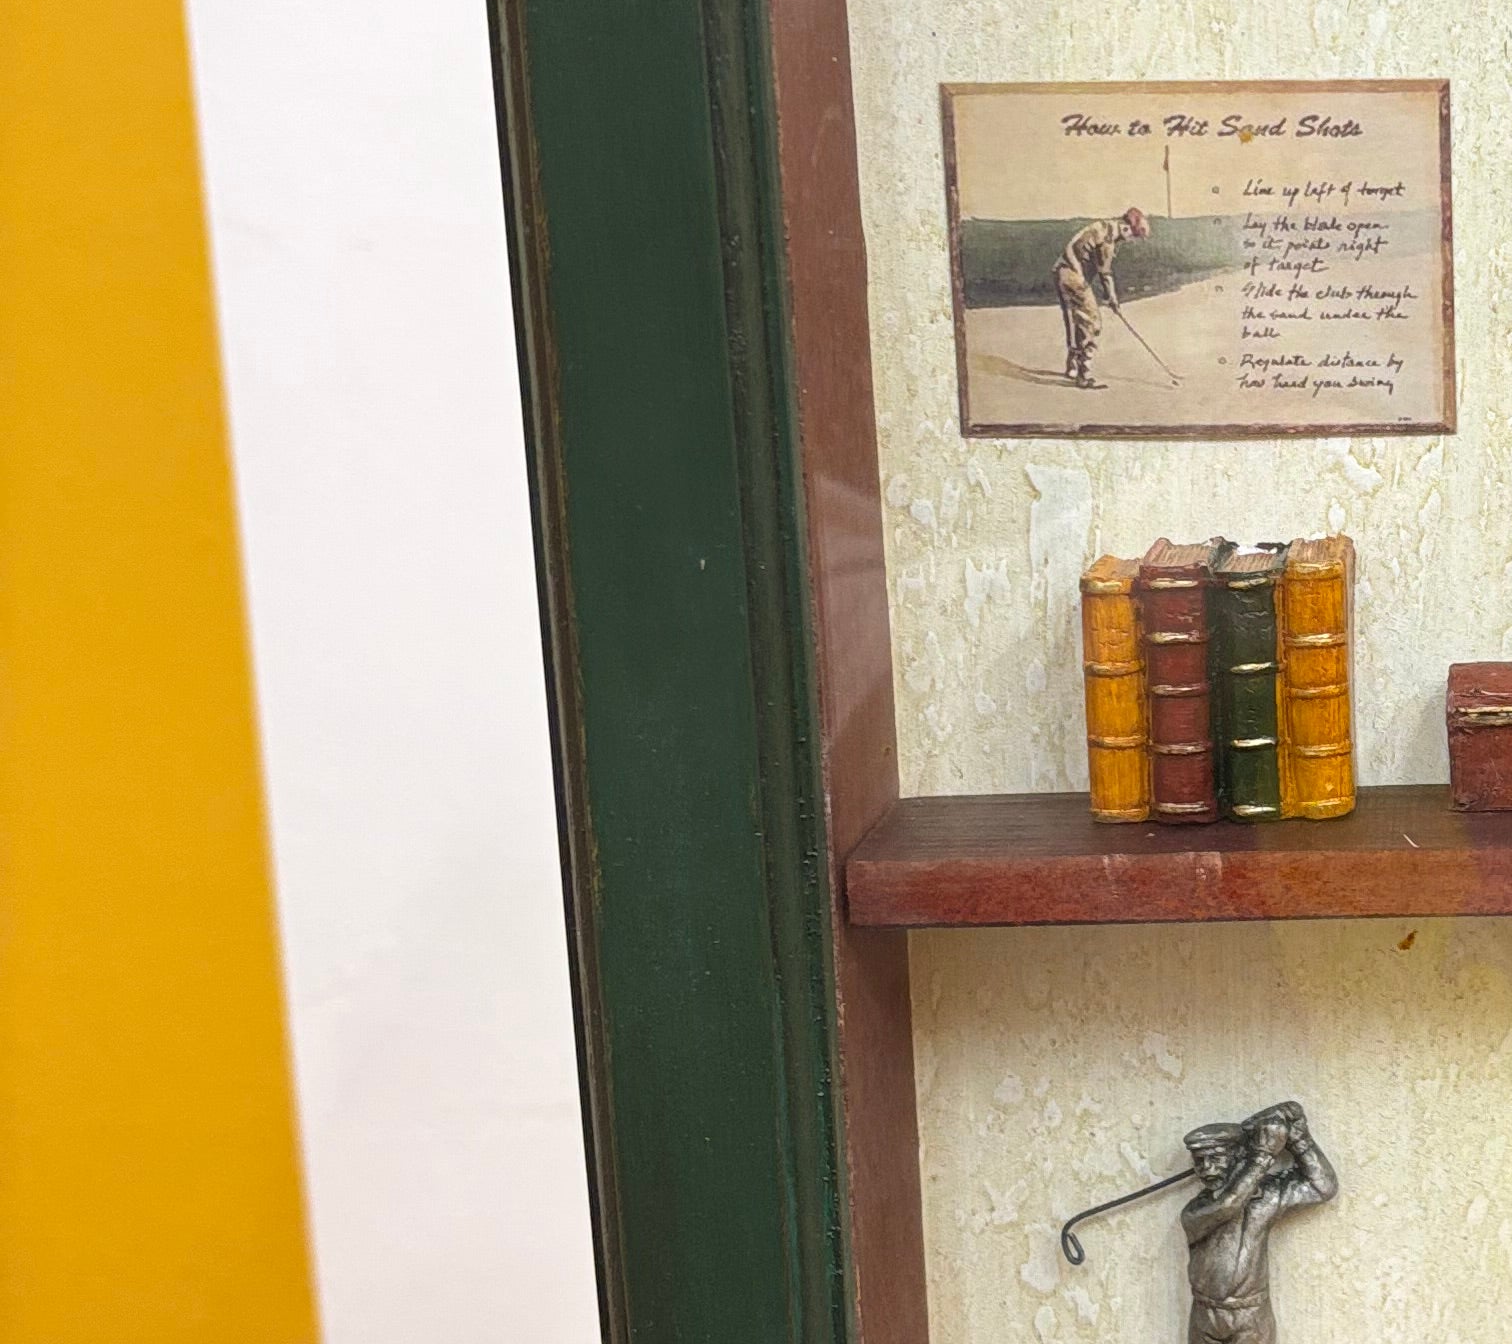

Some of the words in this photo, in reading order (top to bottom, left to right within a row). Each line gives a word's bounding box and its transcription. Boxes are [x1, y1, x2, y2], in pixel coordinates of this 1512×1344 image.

[1061, 114, 1121, 137] How
[1127, 119, 1152, 136] to
[1163, 114, 1209, 137] Hit
[1217, 114, 1286, 138] Sand
[1295, 114, 1364, 138] Shots
[1243, 179, 1275, 196] Line
[1282, 185, 1300, 206] up
[1243, 212, 1267, 235] Lay
[1272, 215, 1297, 232] the
[1346, 223, 1389, 239] open
[1337, 236, 1388, 261] right
[1243, 257, 1260, 276] of
[1268, 256, 1330, 278] target
[1288, 283, 1309, 301] the
[1356, 285, 1418, 306] through
[1242, 306, 1266, 319] the
[1376, 306, 1409, 320] the
[1241, 326, 1281, 339] ball
[1240, 354, 1313, 372] Regulate
[1317, 351, 1381, 369] distance
[1387, 353, 1404, 374] by
[1313, 379, 1342, 399] you
[1347, 376, 1394, 396] swing
